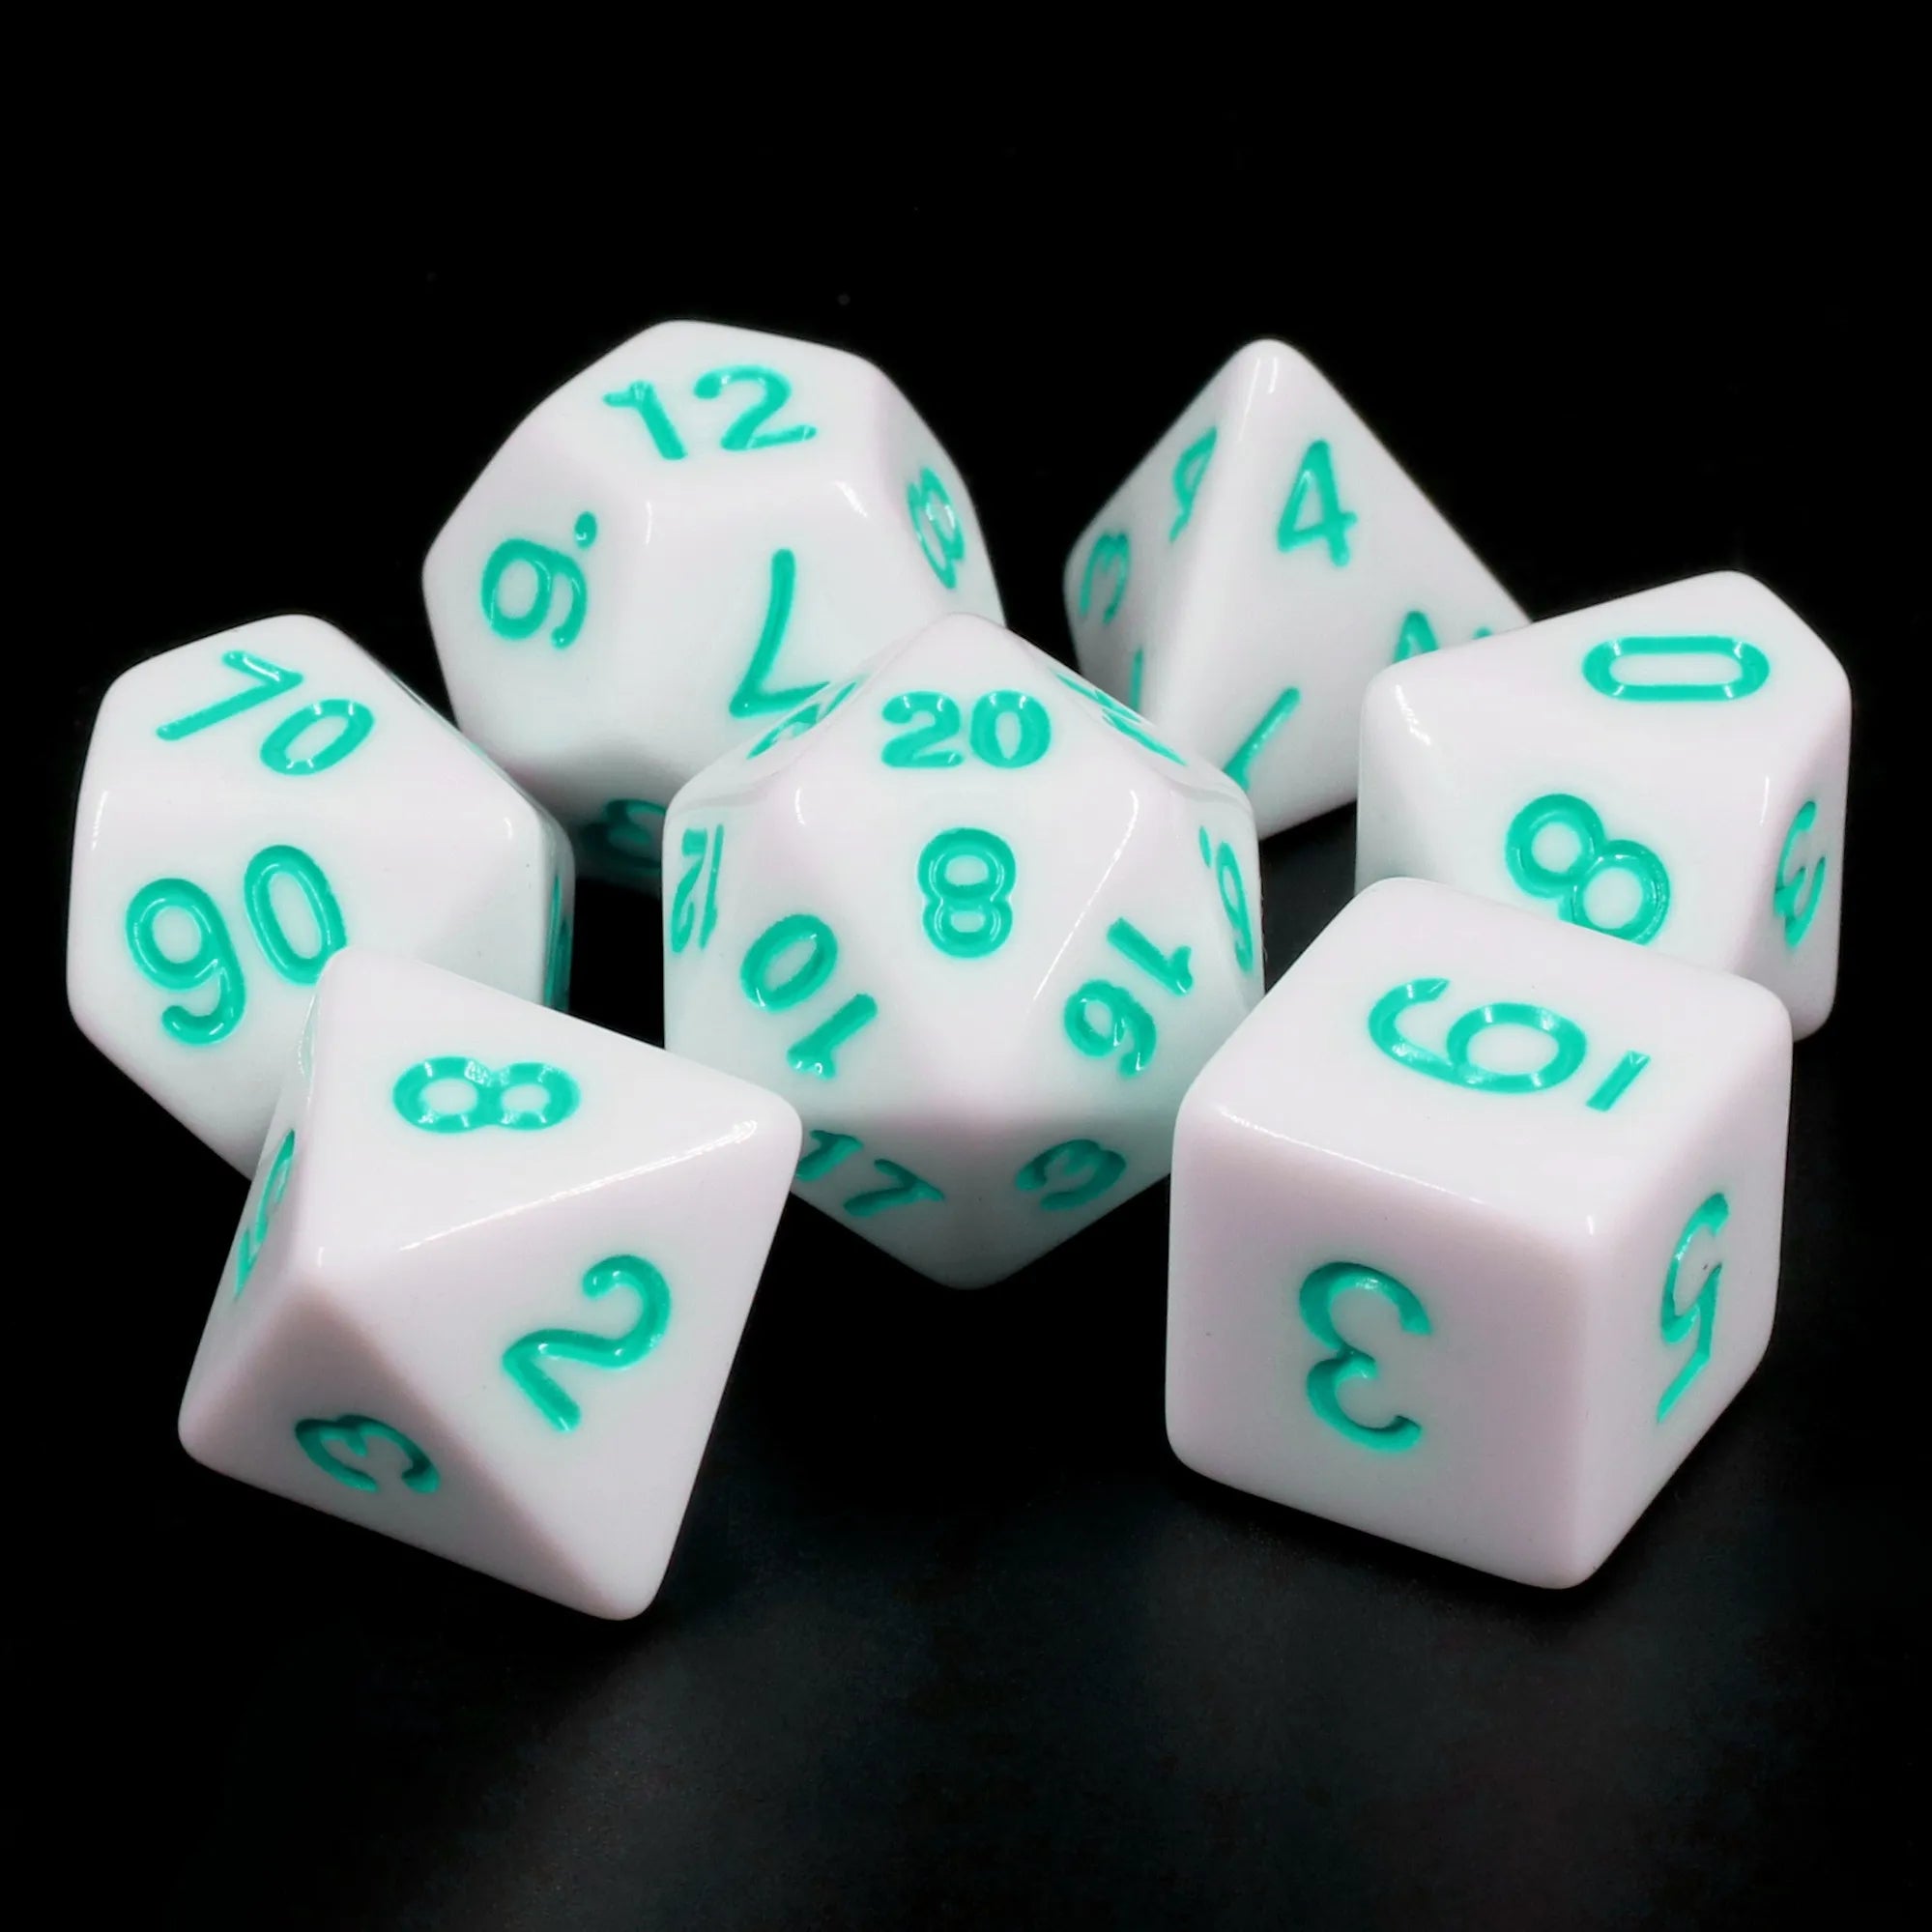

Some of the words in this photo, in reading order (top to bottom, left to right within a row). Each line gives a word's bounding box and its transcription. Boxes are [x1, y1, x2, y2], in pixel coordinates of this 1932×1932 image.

[603, 365, 818, 461] 12
[1277, 439, 1358, 567] 4
[729, 548, 831, 720] 7
[1079, 532, 1131, 624] 3
[156, 650, 375, 776] 70
[880, 689, 1053, 769] 20
[1581, 635, 1772, 703] 0
[668, 825, 724, 956] 12
[917, 827, 1017, 961] 8
[1504, 793, 1672, 945] 8
[124, 845, 349, 1048] 90
[738, 913, 879, 1081] 10
[1062, 917, 1195, 1081] 16
[391, 1055, 581, 1135] 8
[501, 1254, 673, 1433] 2
[1297, 1261, 1434, 1456] 3
[1657, 1193, 1730, 1422] 5
[294, 1413, 441, 1495] 3
